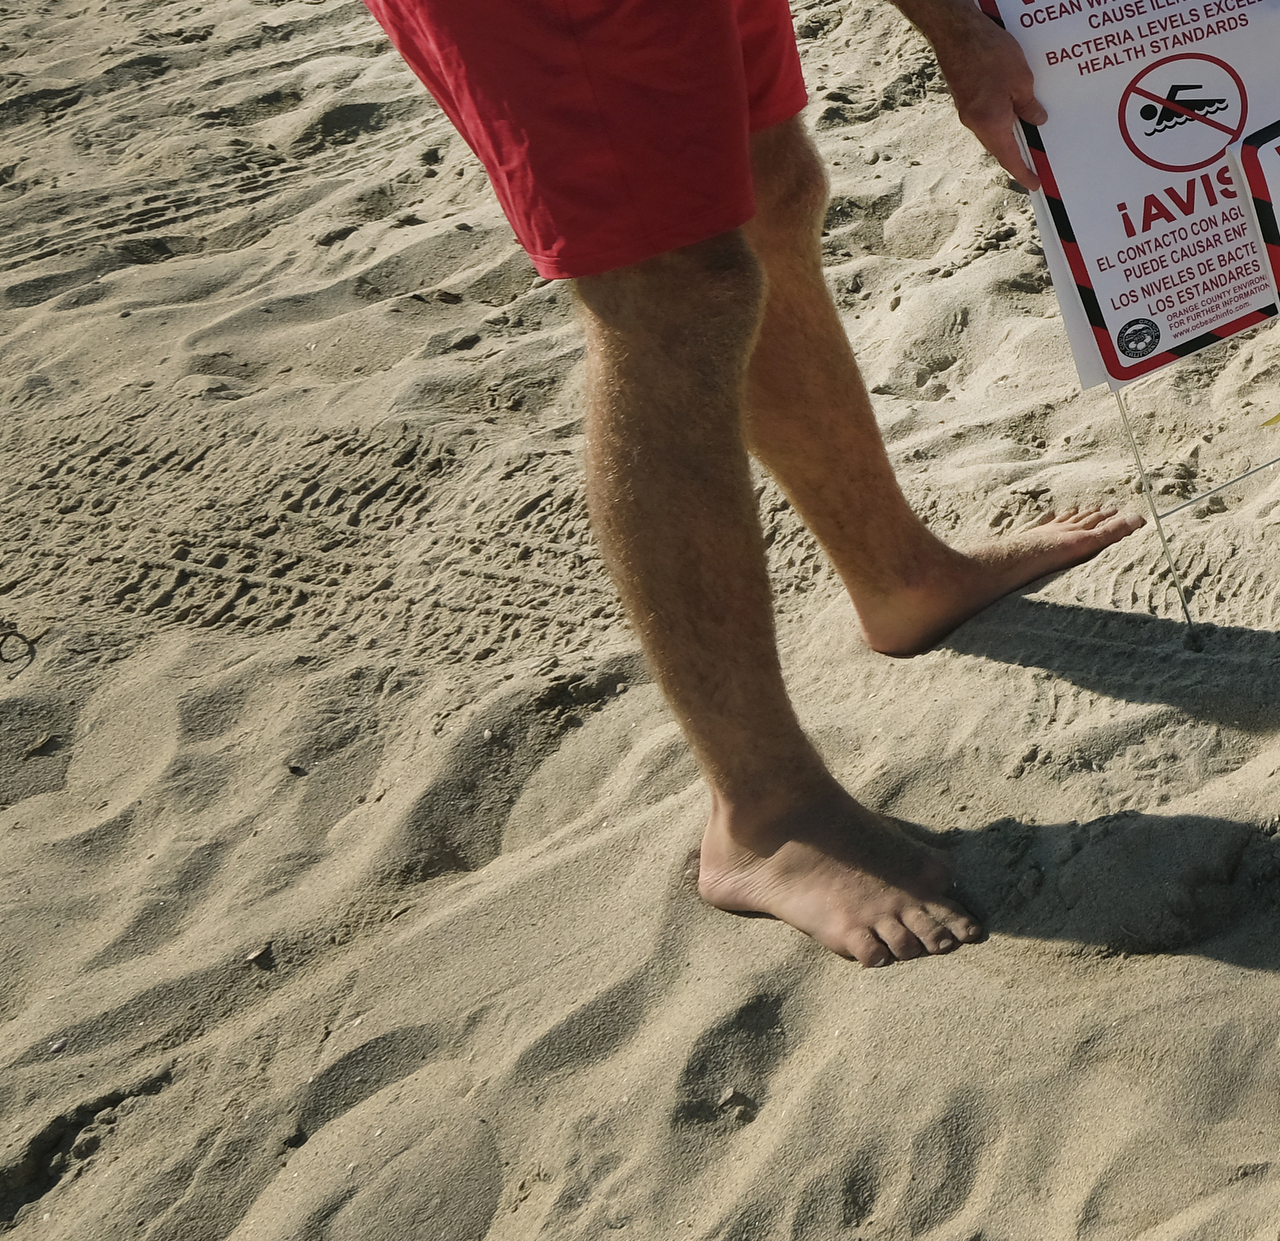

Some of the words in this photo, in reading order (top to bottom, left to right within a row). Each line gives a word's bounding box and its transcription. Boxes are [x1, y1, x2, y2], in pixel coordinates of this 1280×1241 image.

[1045, 28, 1135, 66] BACTERIA
[1136, 7, 1200, 39] LEVELS
[1076, 43, 1146, 76] HEALTH
[1149, 12, 1249, 54] STANDARDS
[1087, 0, 1147, 29] CAUSE
